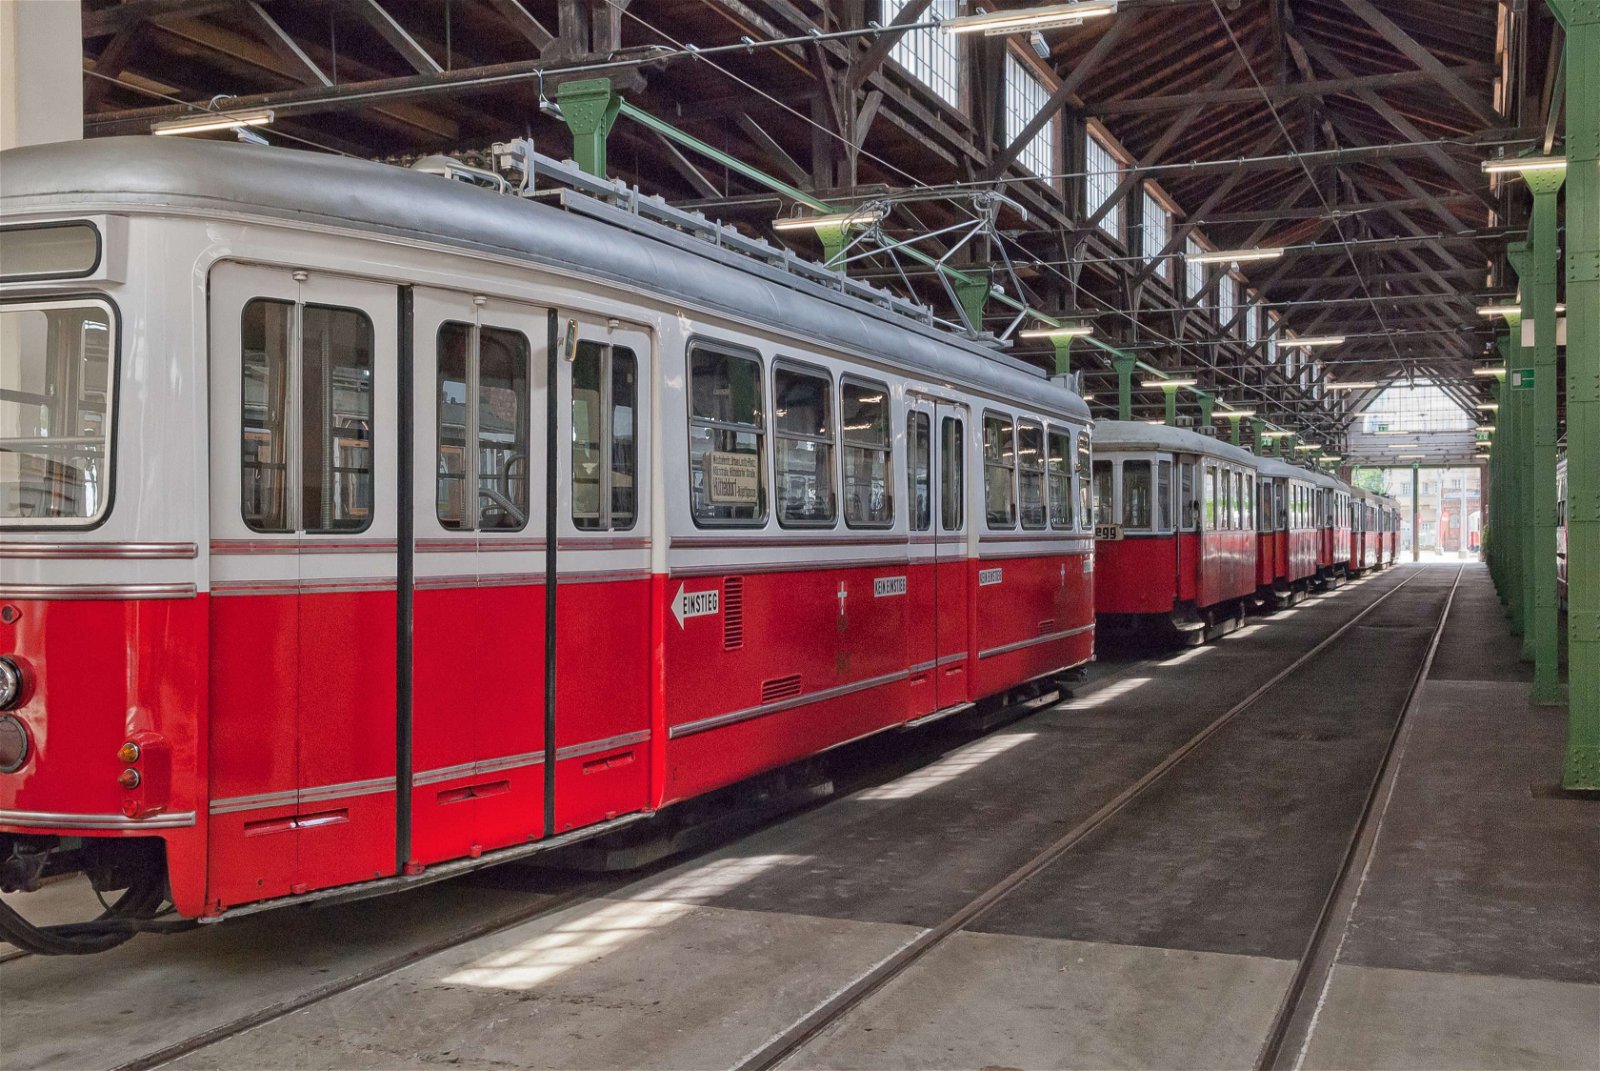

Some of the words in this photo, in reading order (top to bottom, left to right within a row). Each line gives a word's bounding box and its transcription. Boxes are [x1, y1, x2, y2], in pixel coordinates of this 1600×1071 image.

[875, 580, 885, 594] KEIN
[887, 578, 905, 593] EINSTIEG
[683, 593, 717, 614] EINSTIEG
